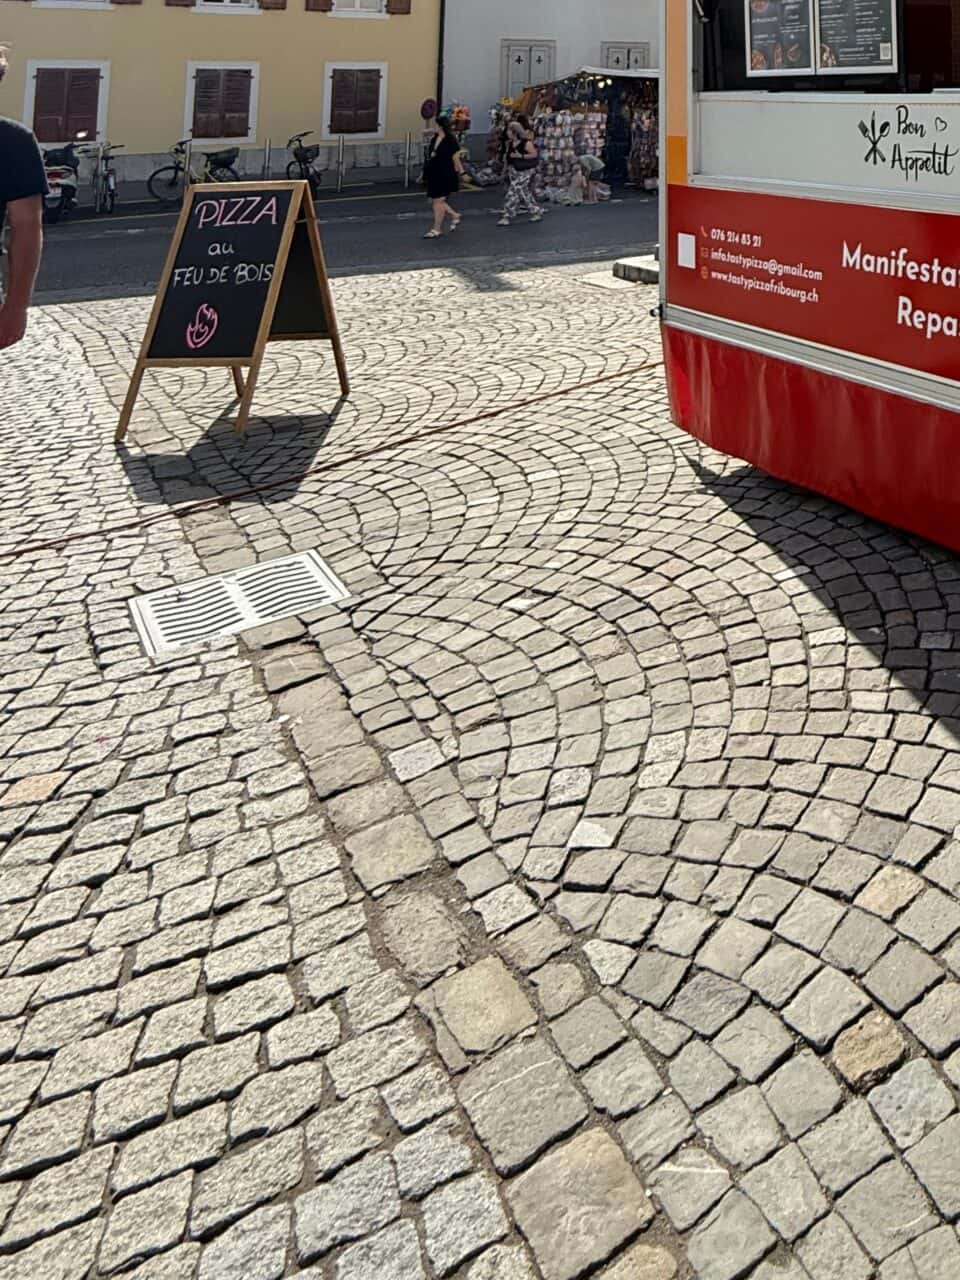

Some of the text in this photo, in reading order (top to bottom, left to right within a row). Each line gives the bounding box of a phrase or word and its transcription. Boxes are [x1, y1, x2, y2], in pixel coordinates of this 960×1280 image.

[896, 105, 927, 138] Bon
[891, 142, 960, 181] Appetit
[194, 196, 278, 228] PIZZA
[207, 242, 235, 256] au
[711, 228, 726, 241] 076
[727, 230, 740, 243] 214
[752, 235, 762, 247] 21
[173, 263, 275, 287] FEU DE BOIS
[711, 271, 819, 302] www.tastypizzafribourg.ch
